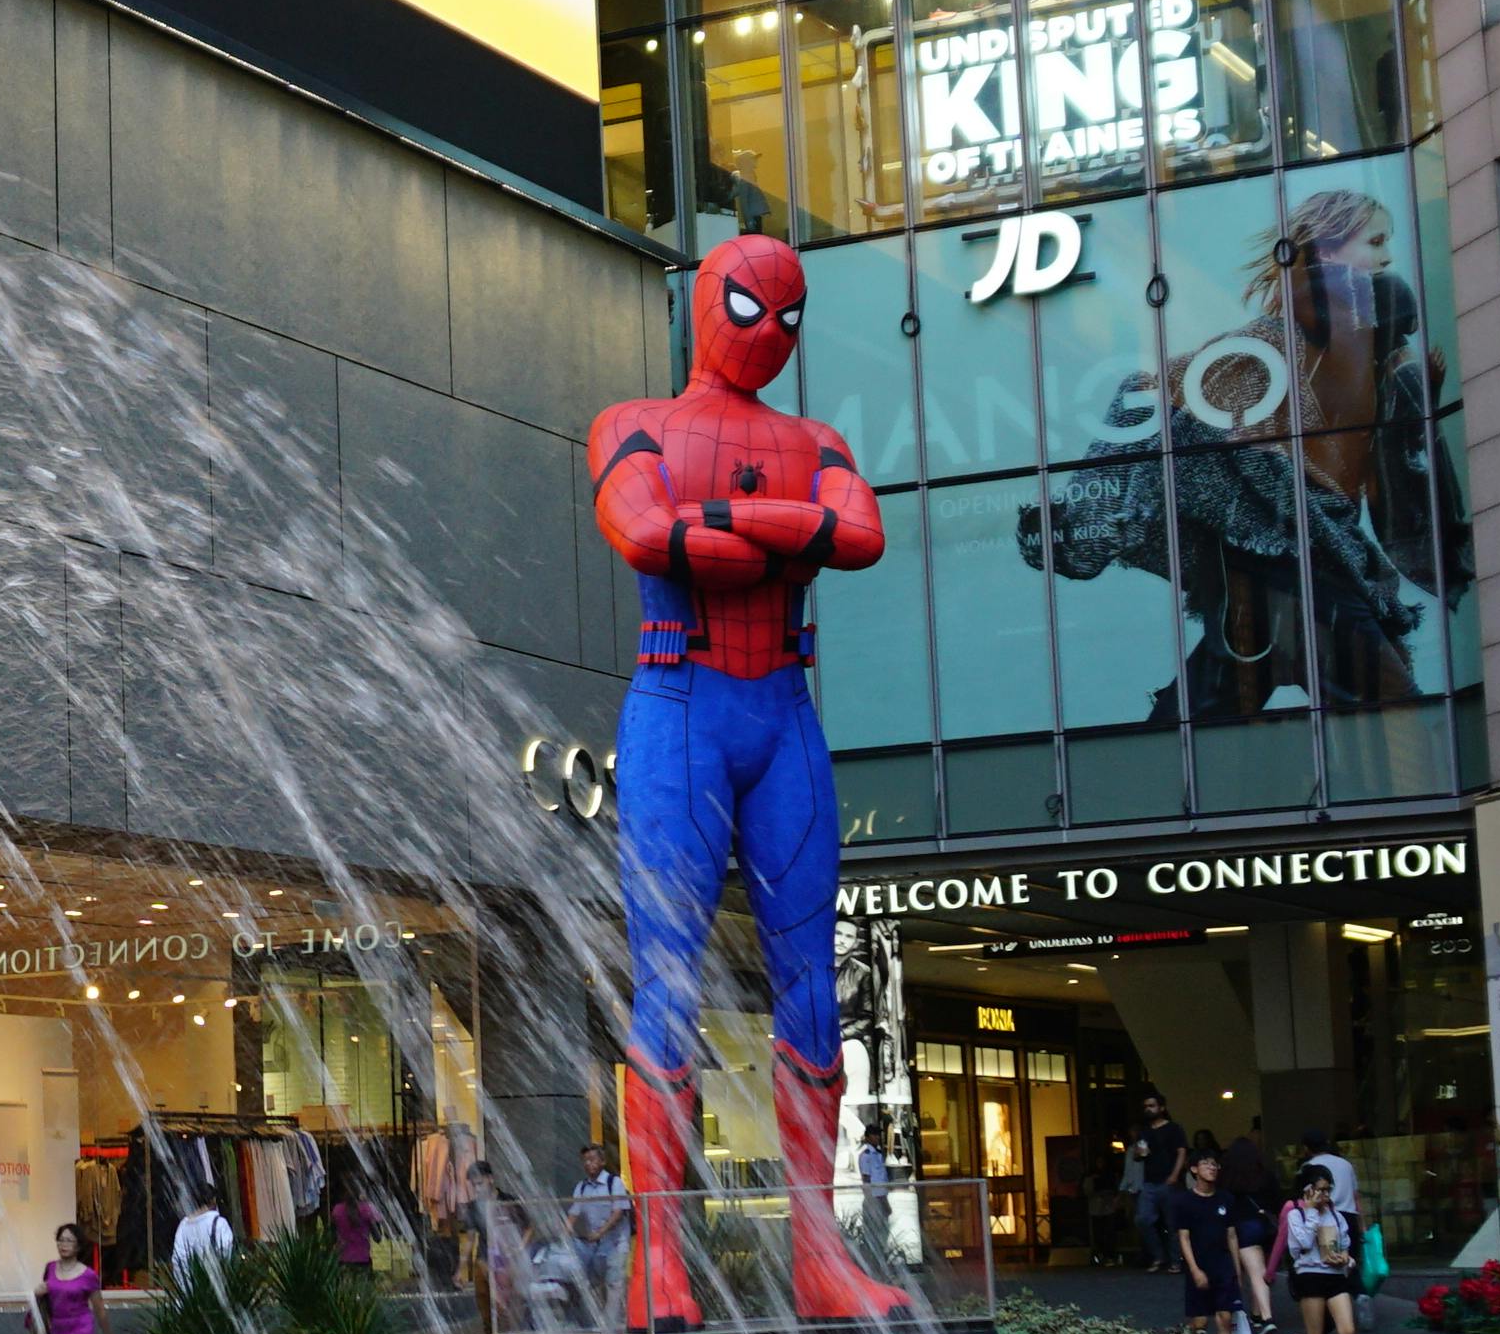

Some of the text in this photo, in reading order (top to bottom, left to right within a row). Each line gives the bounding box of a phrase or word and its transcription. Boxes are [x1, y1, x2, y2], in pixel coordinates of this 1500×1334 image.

[921, 29, 1199, 151] KING
[927, 145, 980, 184] OF
[971, 208, 1083, 306] JD
[1053, 479, 1120, 505] SOON
[1027, 528, 1063, 546] MN
[1073, 524, 1112, 541] KIDS
[1058, 867, 1118, 901] TO
[1147, 842, 1467, 894] CONNECTION
